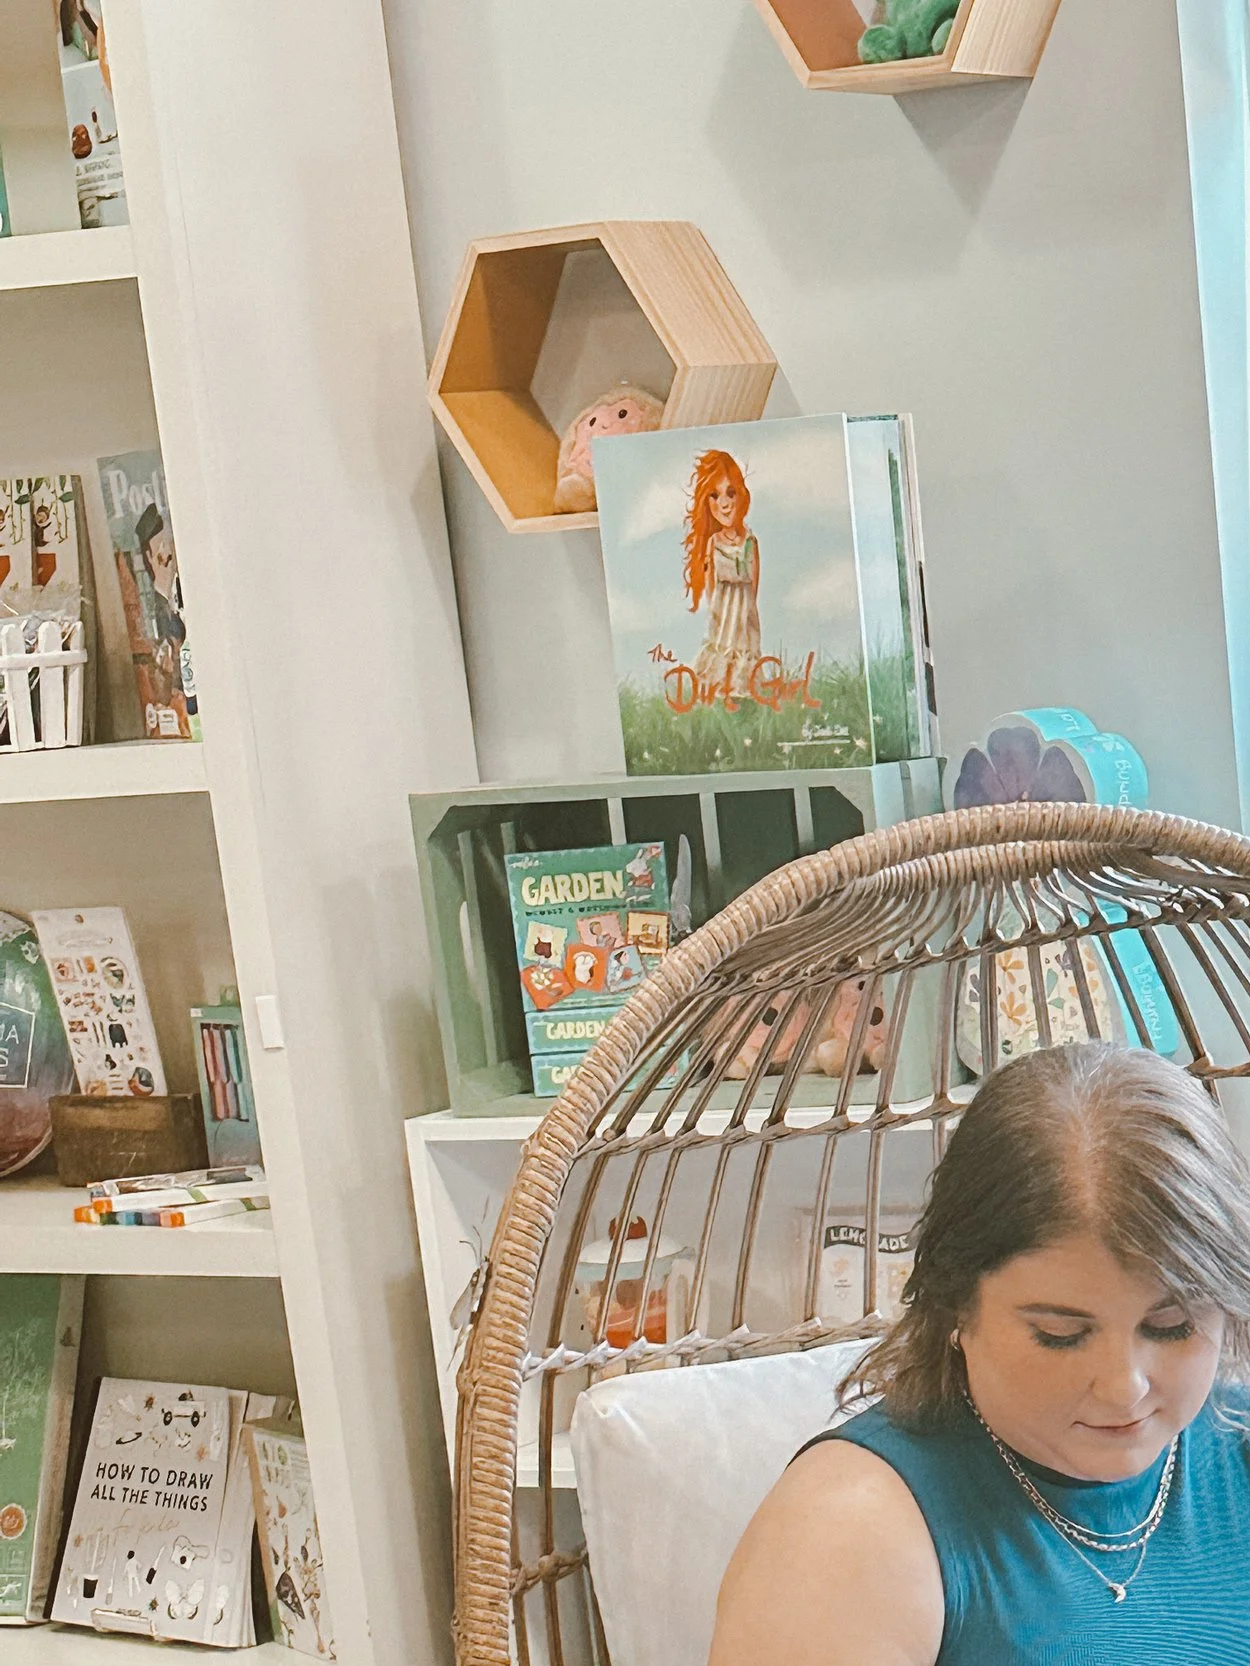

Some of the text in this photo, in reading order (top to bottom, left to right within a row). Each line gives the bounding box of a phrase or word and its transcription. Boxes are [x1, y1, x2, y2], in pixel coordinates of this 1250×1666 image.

[106, 469, 164, 518] Post
[647, 643, 678, 663] The
[663, 651, 822, 714] Dirt Girl
[521, 869, 626, 907] GARDEN
[830, 1227, 909, 1251] LEMADE
[96, 1462, 213, 1489] HOW TO DRAW
[90, 1484, 207, 1511] ALL THE THINGS
